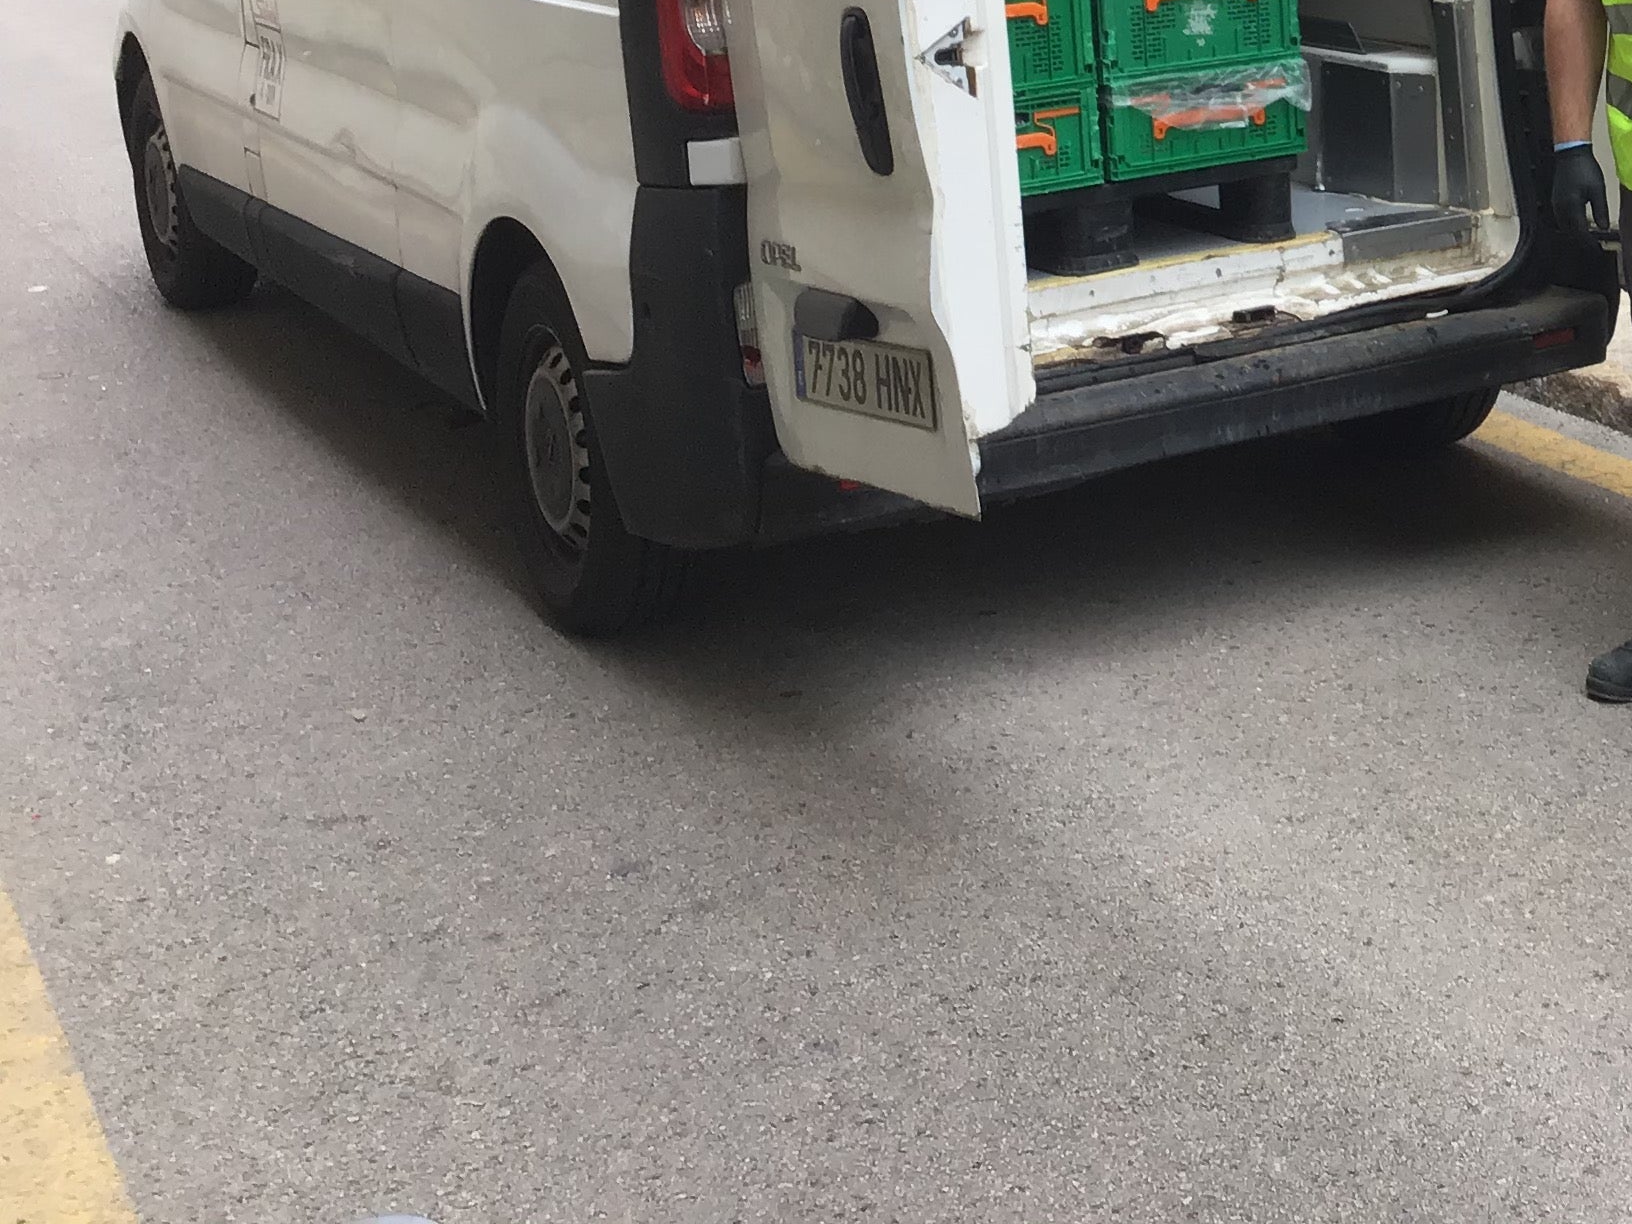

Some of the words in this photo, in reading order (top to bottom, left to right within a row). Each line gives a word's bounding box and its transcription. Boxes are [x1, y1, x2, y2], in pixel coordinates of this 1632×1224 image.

[760, 240, 802, 272] OPEL
[808, 340, 867, 405] 7738
[875, 353, 926, 419] HNX
